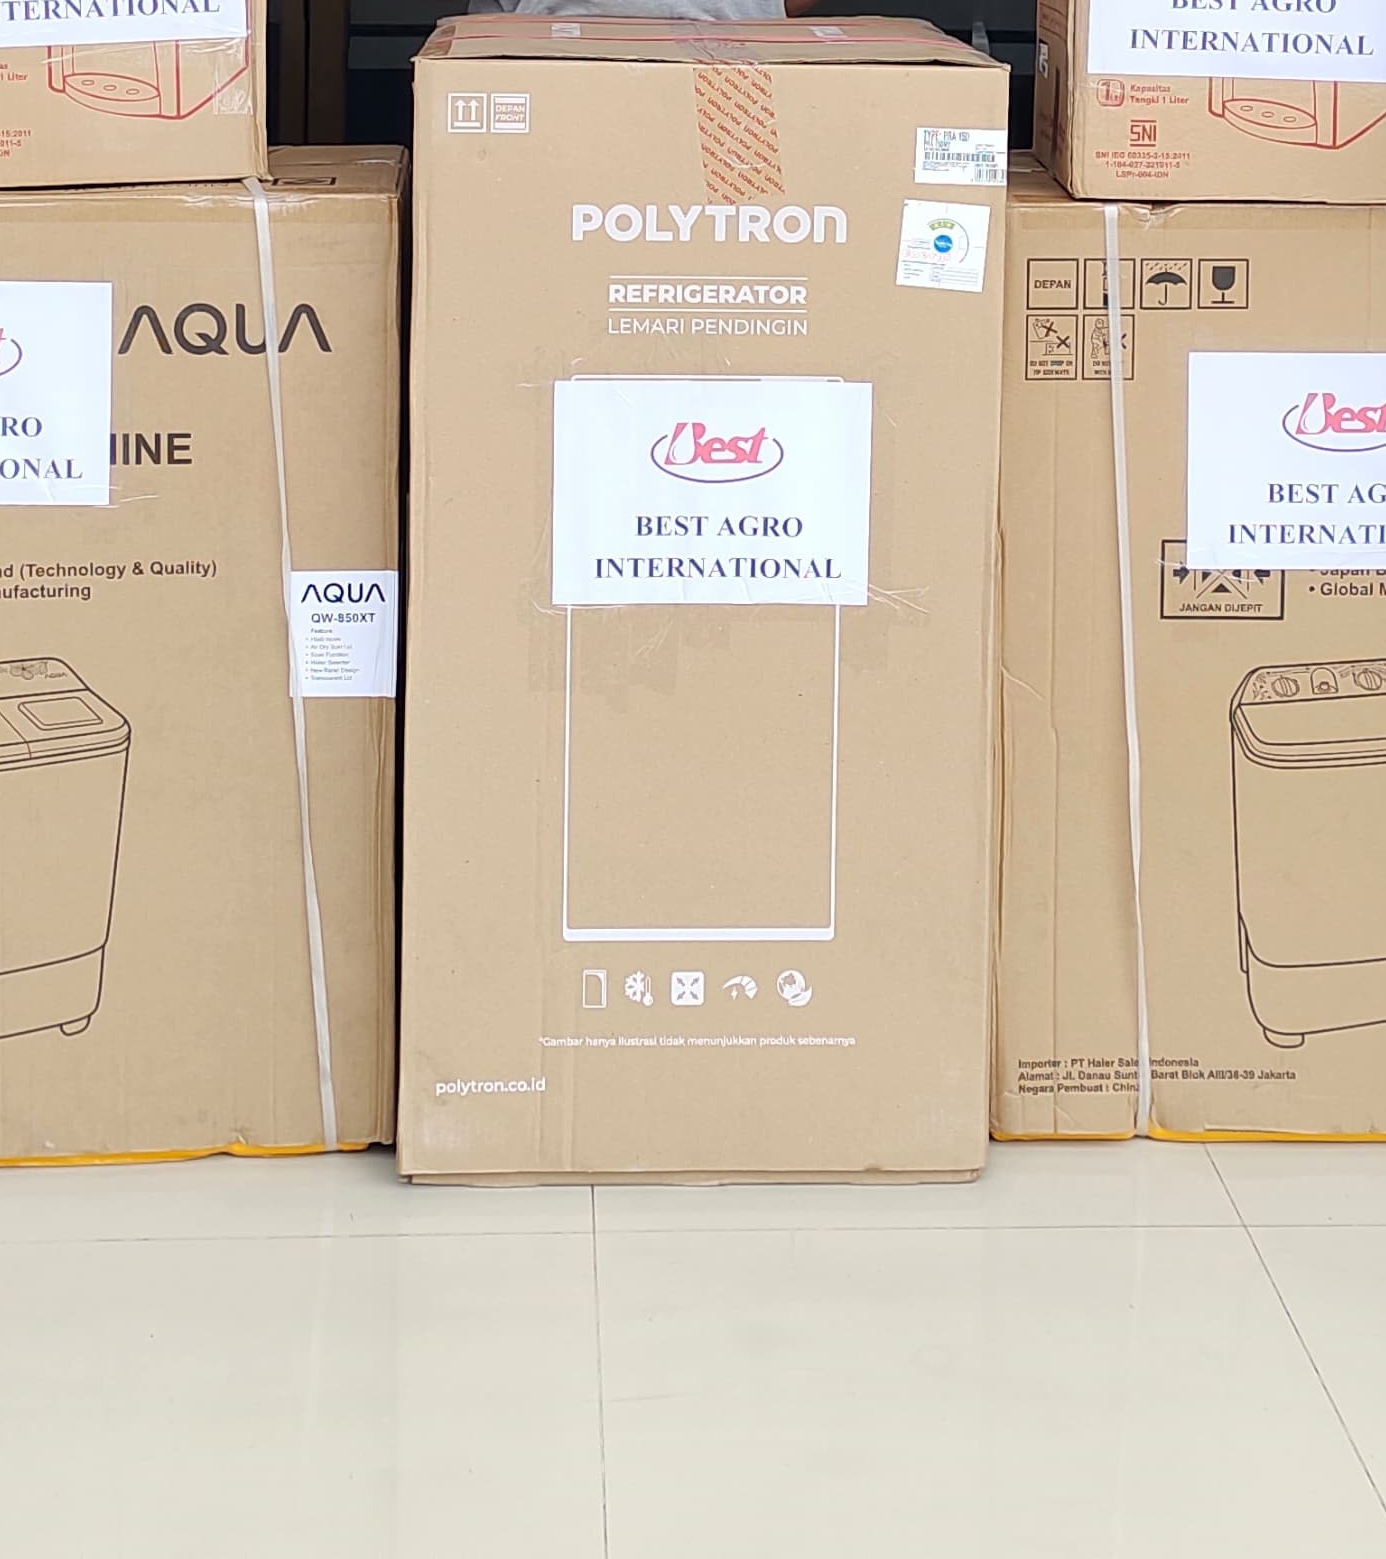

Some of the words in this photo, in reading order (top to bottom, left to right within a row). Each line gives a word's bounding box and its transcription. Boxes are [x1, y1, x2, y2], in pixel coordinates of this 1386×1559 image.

[1130, 28, 1374, 56] INTERNATIONAL
[7, 73, 28, 81] Liter
[496, 104, 525, 112] DEPAN
[1169, 96, 1189, 104] Liter
[1130, 120, 1157, 147] SNI
[572, 205, 847, 243] POLYTRON
[1034, 279, 1071, 289] DEPAN
[608, 284, 807, 304] REFRIGERATOR
[118, 303, 332, 355] AQUA
[608, 318, 684, 334] LEMARI
[691, 319, 807, 336] PENDINGIN
[664, 423, 768, 465] Best
[1268, 483, 1339, 504] BEST
[634, 516, 708, 537] BEST
[716, 516, 803, 537] AGRO
[19, 562, 125, 580] (Technology
[132, 561, 144, 574] &
[150, 559, 217, 577] Quality)
[594, 557, 842, 579] INTERNATIONAL
[301, 583, 386, 603] AQUA
[1320, 582, 1373, 596] Global
[1179, 603, 1221, 612] JANGAN
[1225, 604, 1263, 612] DIJEPIT
[586, 1037, 614, 1048] hanya
[660, 1035, 685, 1046] tidak
[688, 1036, 756, 1047] menunjukkan
[760, 1036, 796, 1047] produk
[1070, 1059, 1085, 1068] PT
[1118, 1057, 1140, 1068] Sale
[1114, 1070, 1139, 1080] Sunt
[1151, 1070, 1179, 1080] Barat
[1258, 1070, 1296, 1080] Jakarta
[436, 1077, 546, 1096] polytron.co.id
